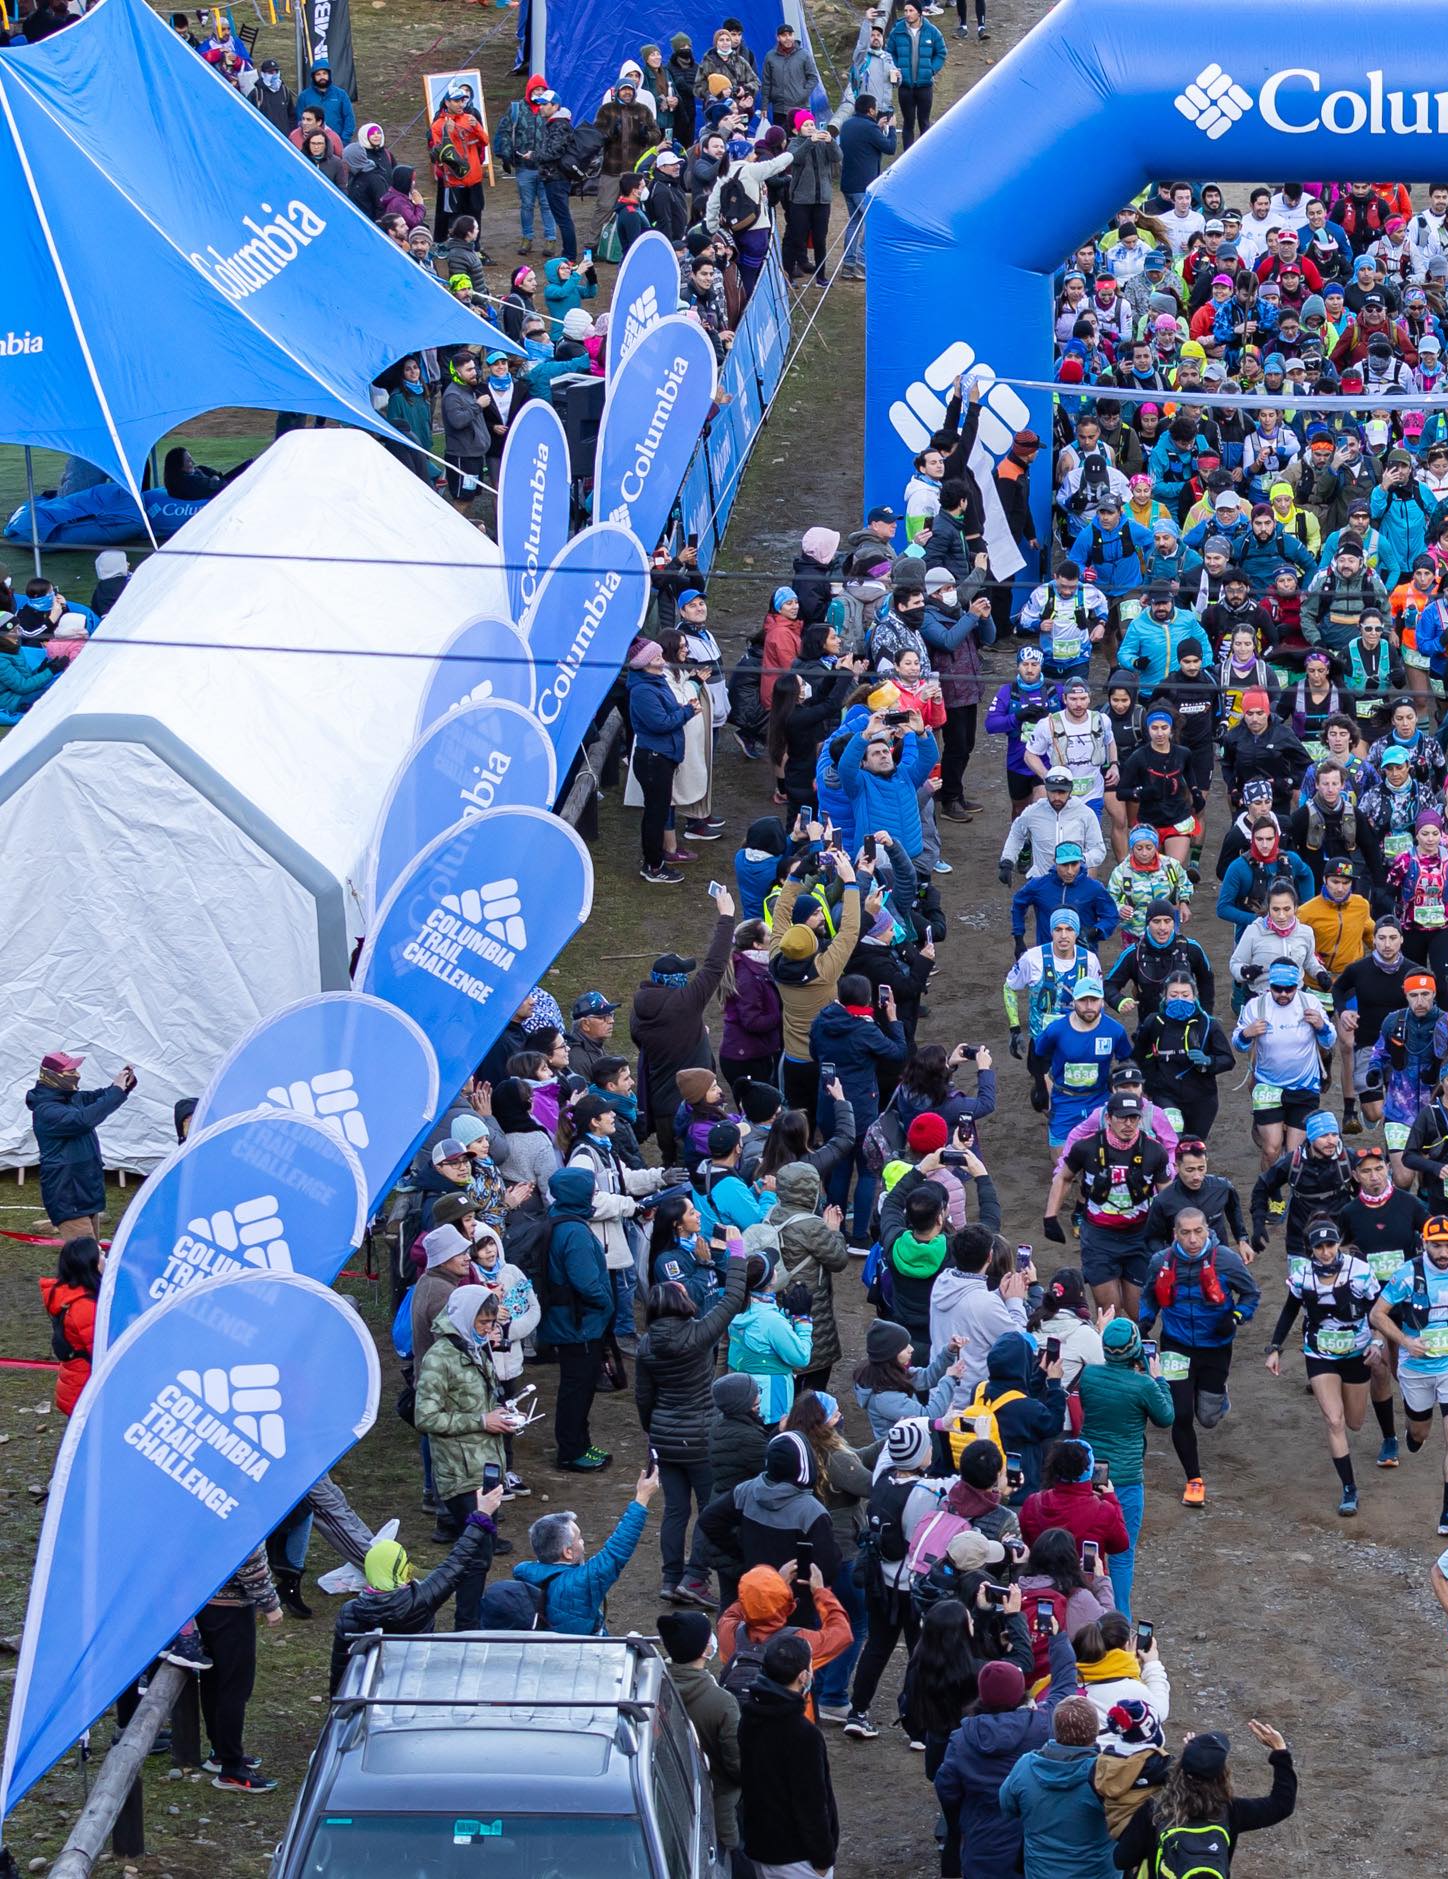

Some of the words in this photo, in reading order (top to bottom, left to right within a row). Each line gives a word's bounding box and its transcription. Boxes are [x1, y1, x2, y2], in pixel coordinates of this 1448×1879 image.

[191, 200, 327, 300] Columbia
[620, 356, 689, 503] Columbia
[520, 442, 549, 605] Columbia
[537, 571, 623, 726] Columbia
[402, 941, 496, 1005] CHALLENGE
[416, 924, 467, 965] TRAIL
[425, 908, 516, 973] COLUMBIA
[123, 1422, 240, 1520] CHALLENGE
[141, 1402, 203, 1462] TRAIL
[156, 1384, 271, 1483] COLUMBIA
